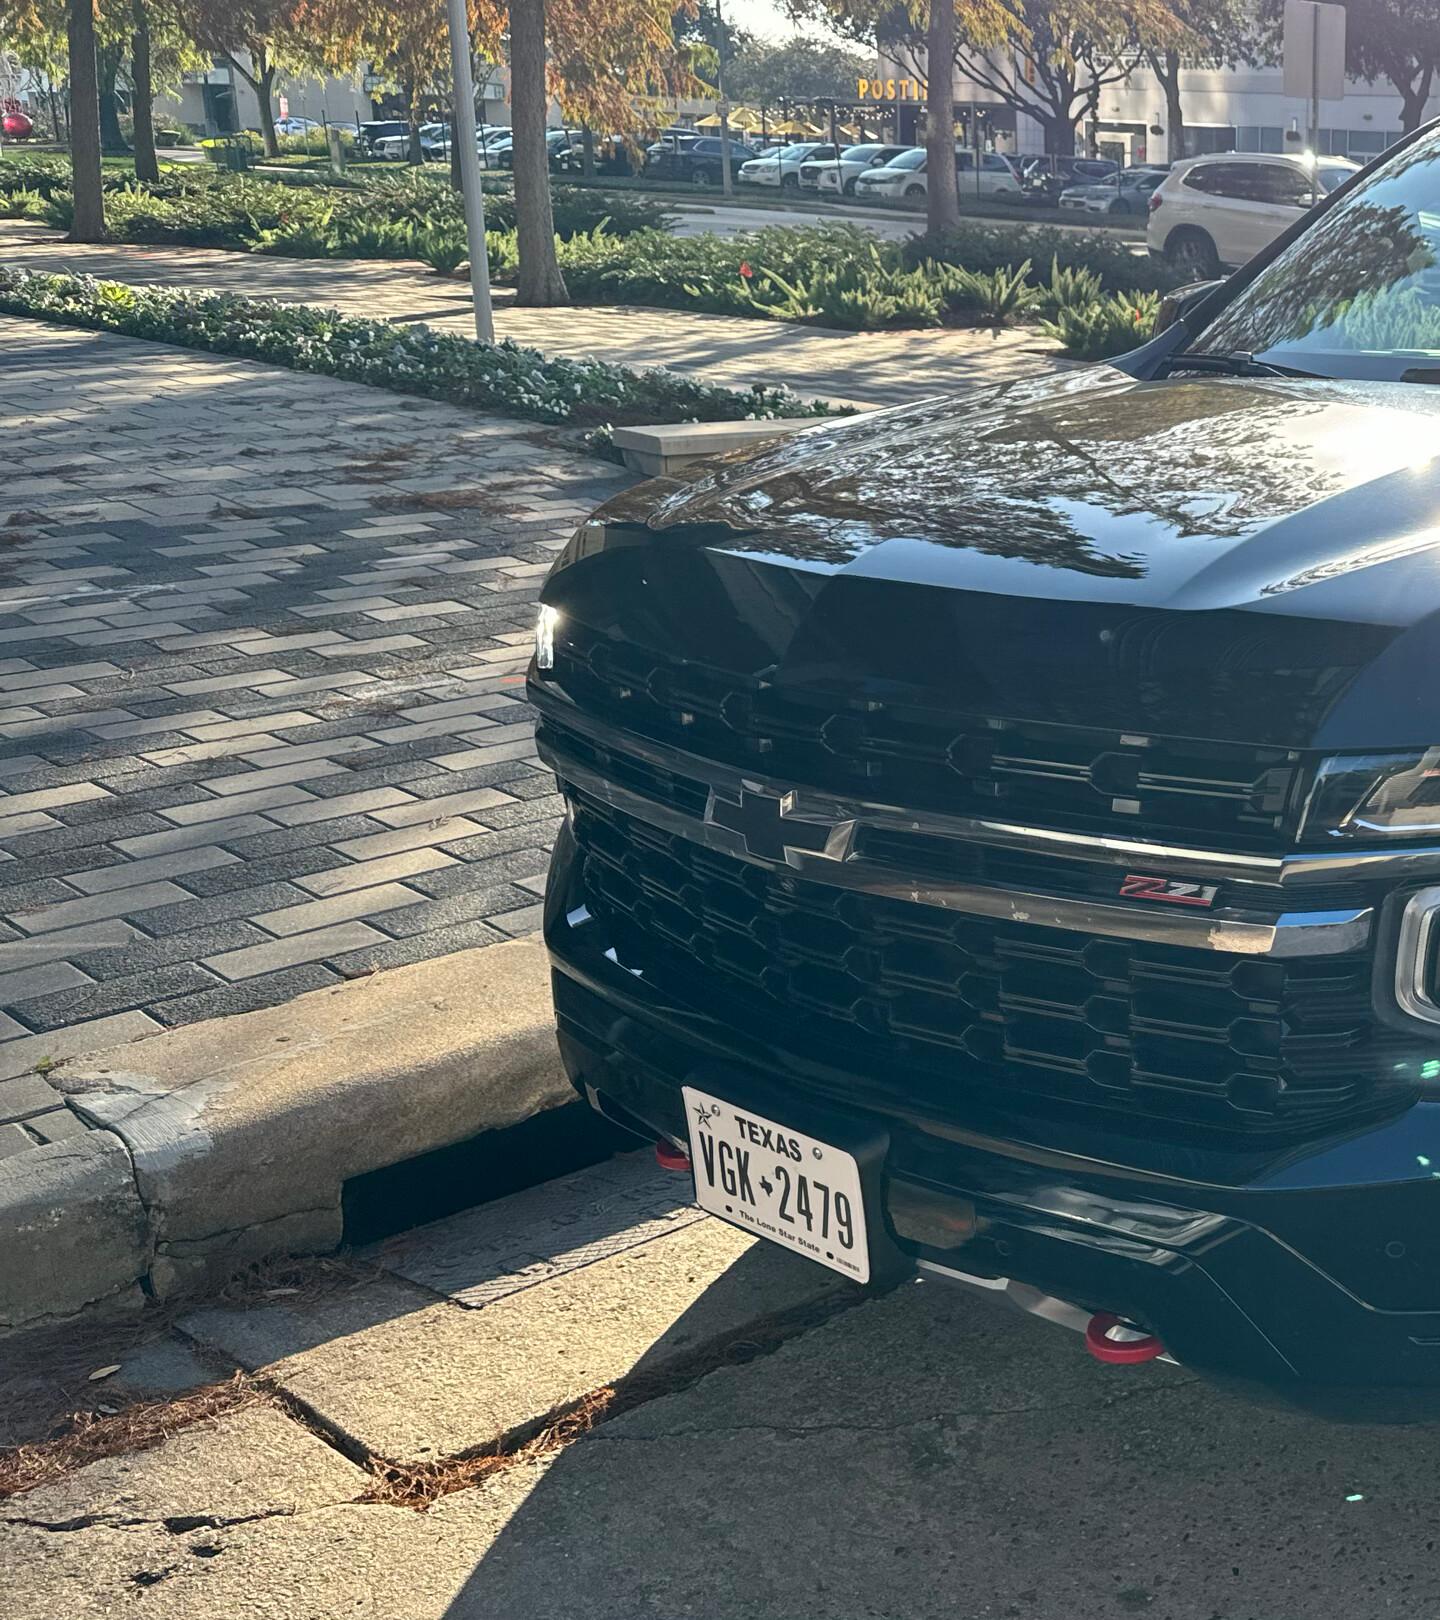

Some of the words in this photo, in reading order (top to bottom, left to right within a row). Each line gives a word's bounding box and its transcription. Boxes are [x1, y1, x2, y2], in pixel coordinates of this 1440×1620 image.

[1119, 874, 1219, 907] Z71
[734, 1115, 802, 1162] TEXAS
[698, 1130, 756, 1207] VGK
[775, 1165, 854, 1250] 2479
[738, 1209, 755, 1224] The
[756, 1217, 776, 1233] Lone
[778, 1227, 796, 1241] Star
[797, 1236, 821, 1253] State
